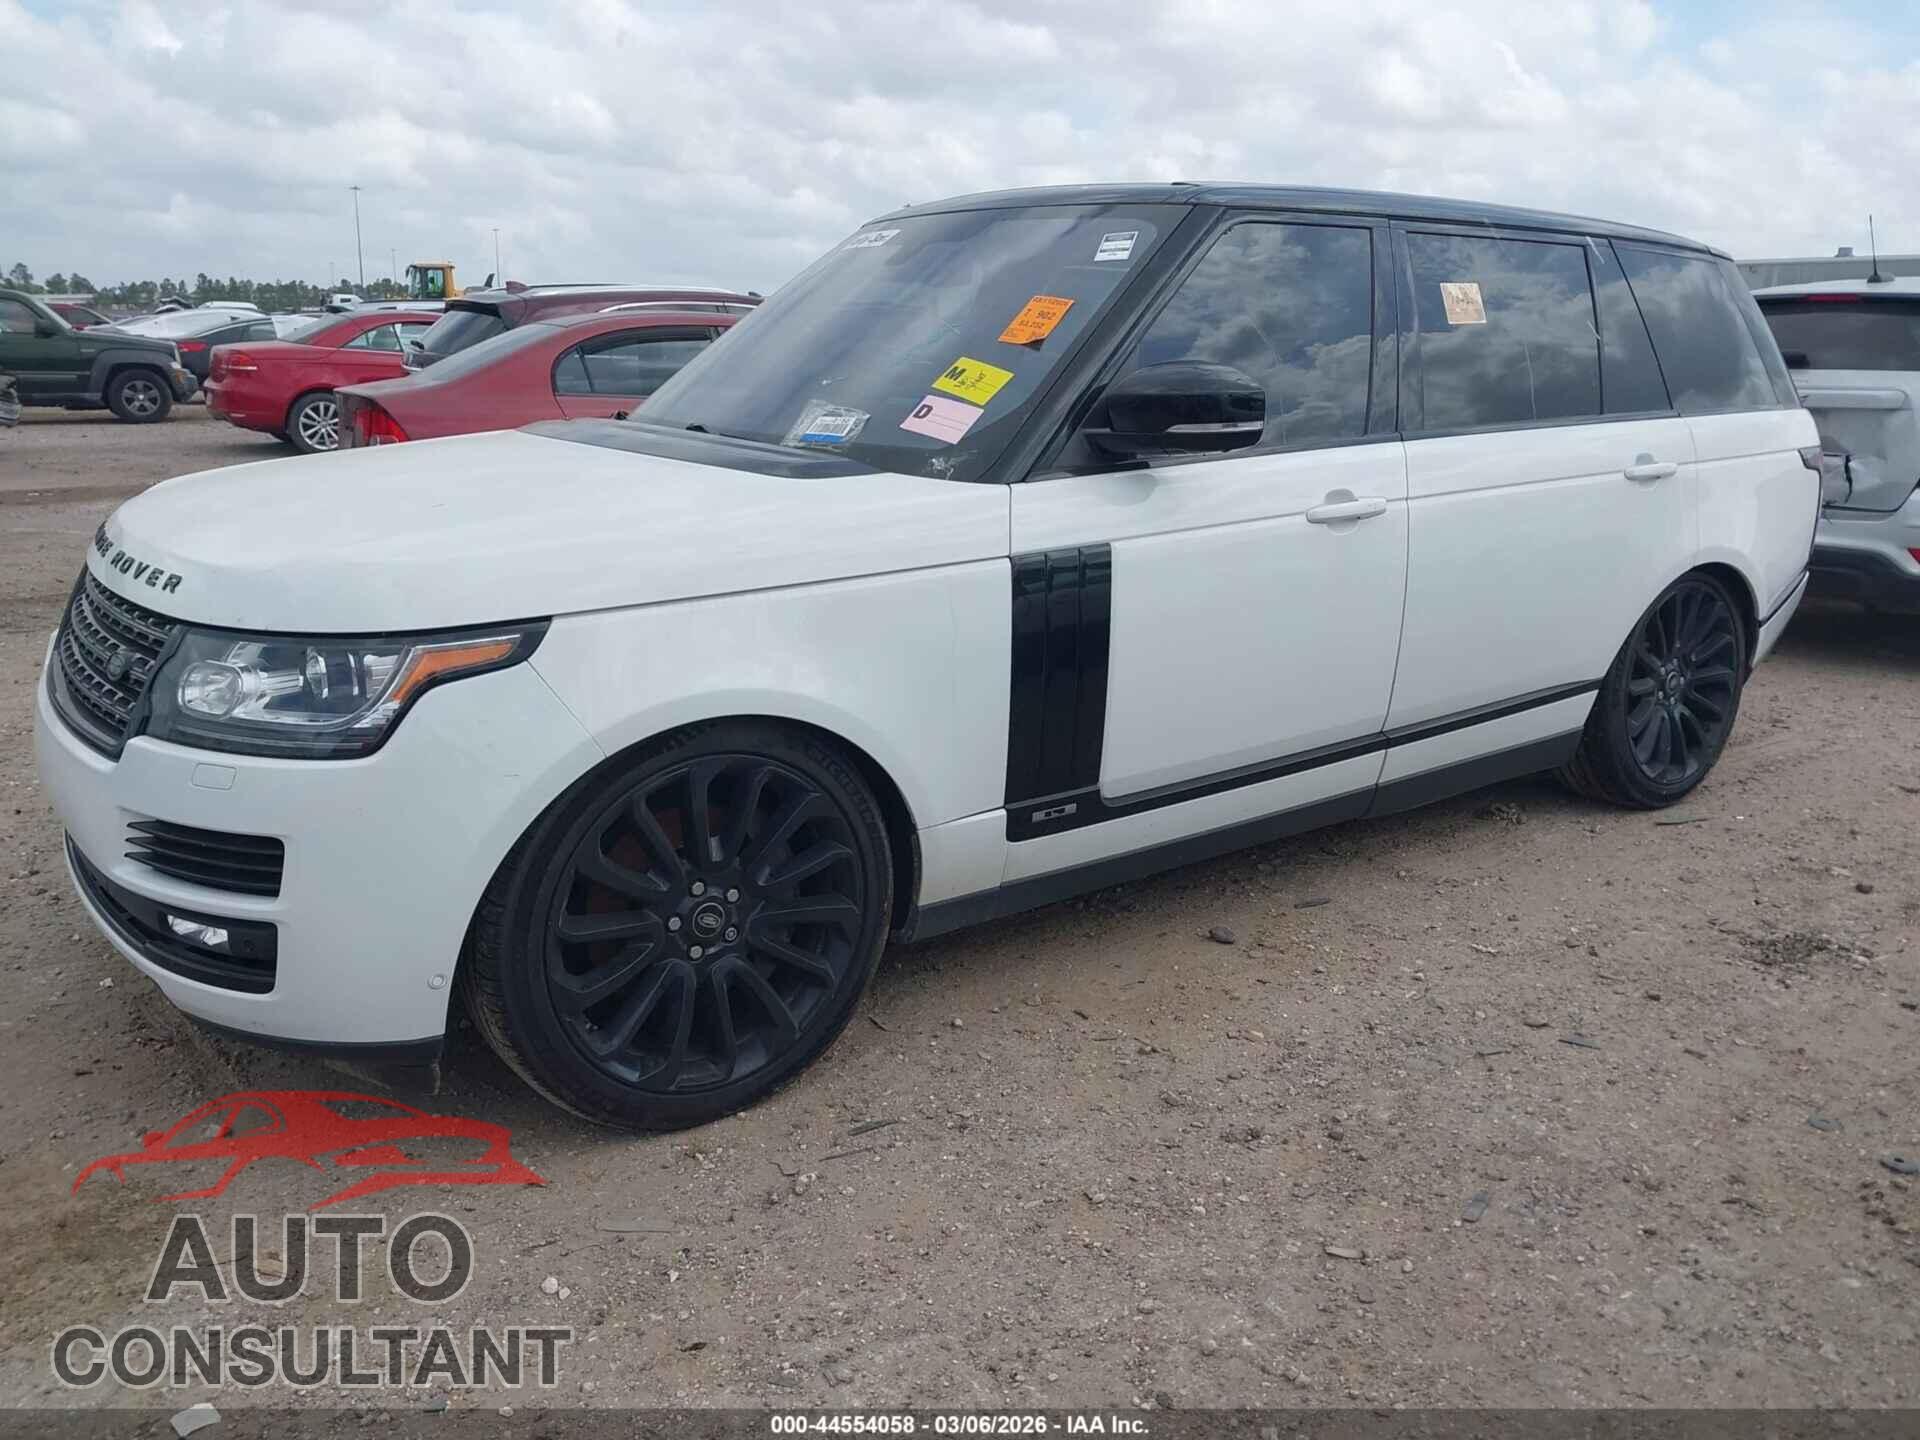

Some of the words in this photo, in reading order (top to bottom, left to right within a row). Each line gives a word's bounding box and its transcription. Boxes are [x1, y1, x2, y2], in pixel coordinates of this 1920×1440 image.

[944, 366, 967, 381] M
[913, 404, 934, 419] D
[110, 550, 183, 594] ROVER
